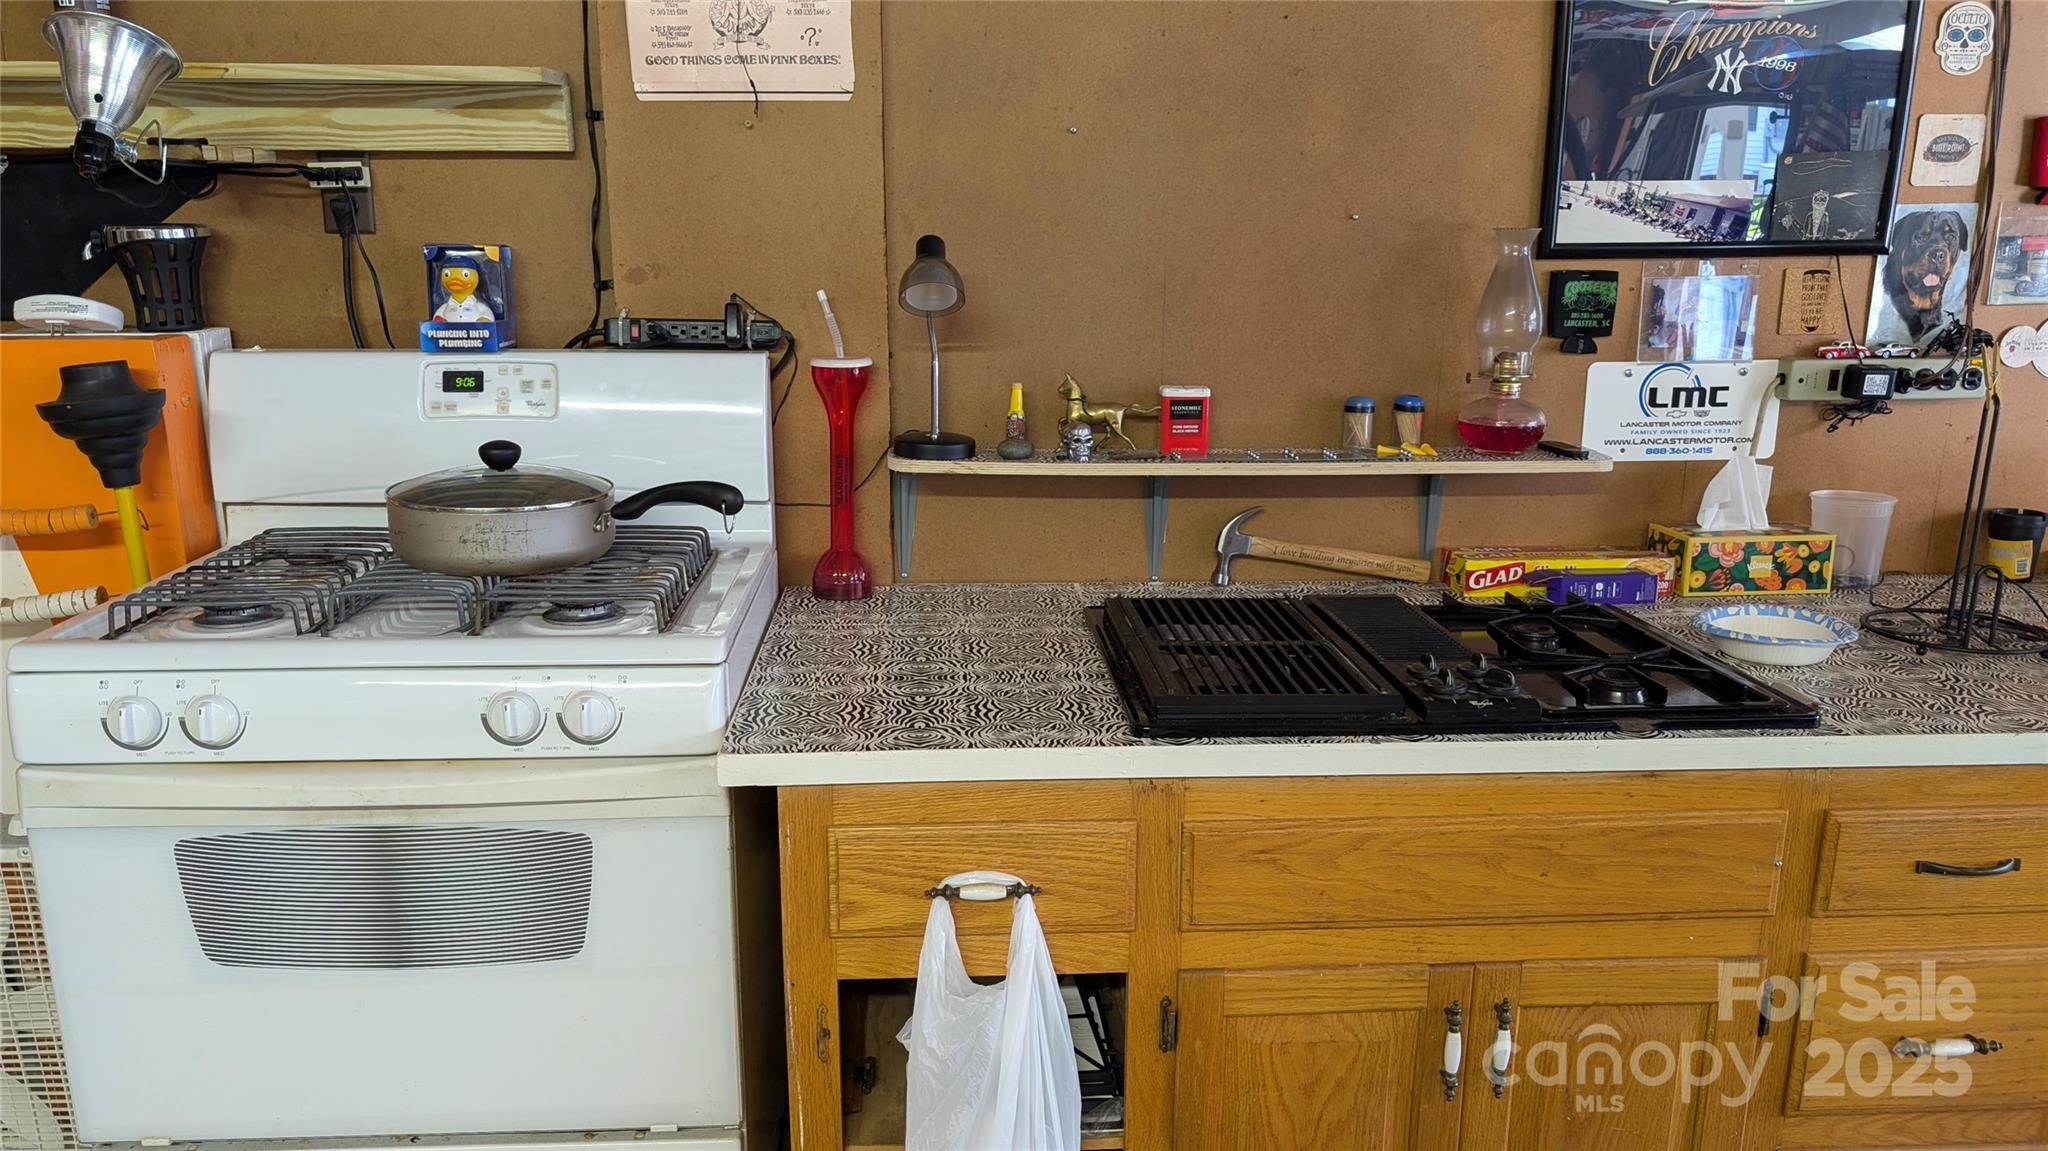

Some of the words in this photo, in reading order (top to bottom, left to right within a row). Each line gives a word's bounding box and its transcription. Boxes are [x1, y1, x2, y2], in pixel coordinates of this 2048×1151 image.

[1951, 12, 1987, 25] OCULTO
[1649, 8, 1818, 87] Champions
[645, 55, 678, 65] GOOD
[680, 55, 722, 65] THINGS
[724, 55, 757, 65] COME
[758, 55, 769, 64] IN
[771, 55, 797, 65] PINK
[1759, 56, 1797, 73] 1998
[428, 330, 468, 338] PLUNGING
[469, 330, 490, 338] INTO
[439, 339, 483, 348] PLUMBING
[455, 377, 475, 387] 9:06
[1648, 386, 1730, 408] LMC
[1645, 446, 1713, 455] 888-360-1415
[1279, 547, 1297, 557] love
[1298, 547, 1335, 565] building
[1337, 556, 1374, 568] memories
[1375, 559, 1395, 570] with
[1468, 566, 1523, 590] GLAD
